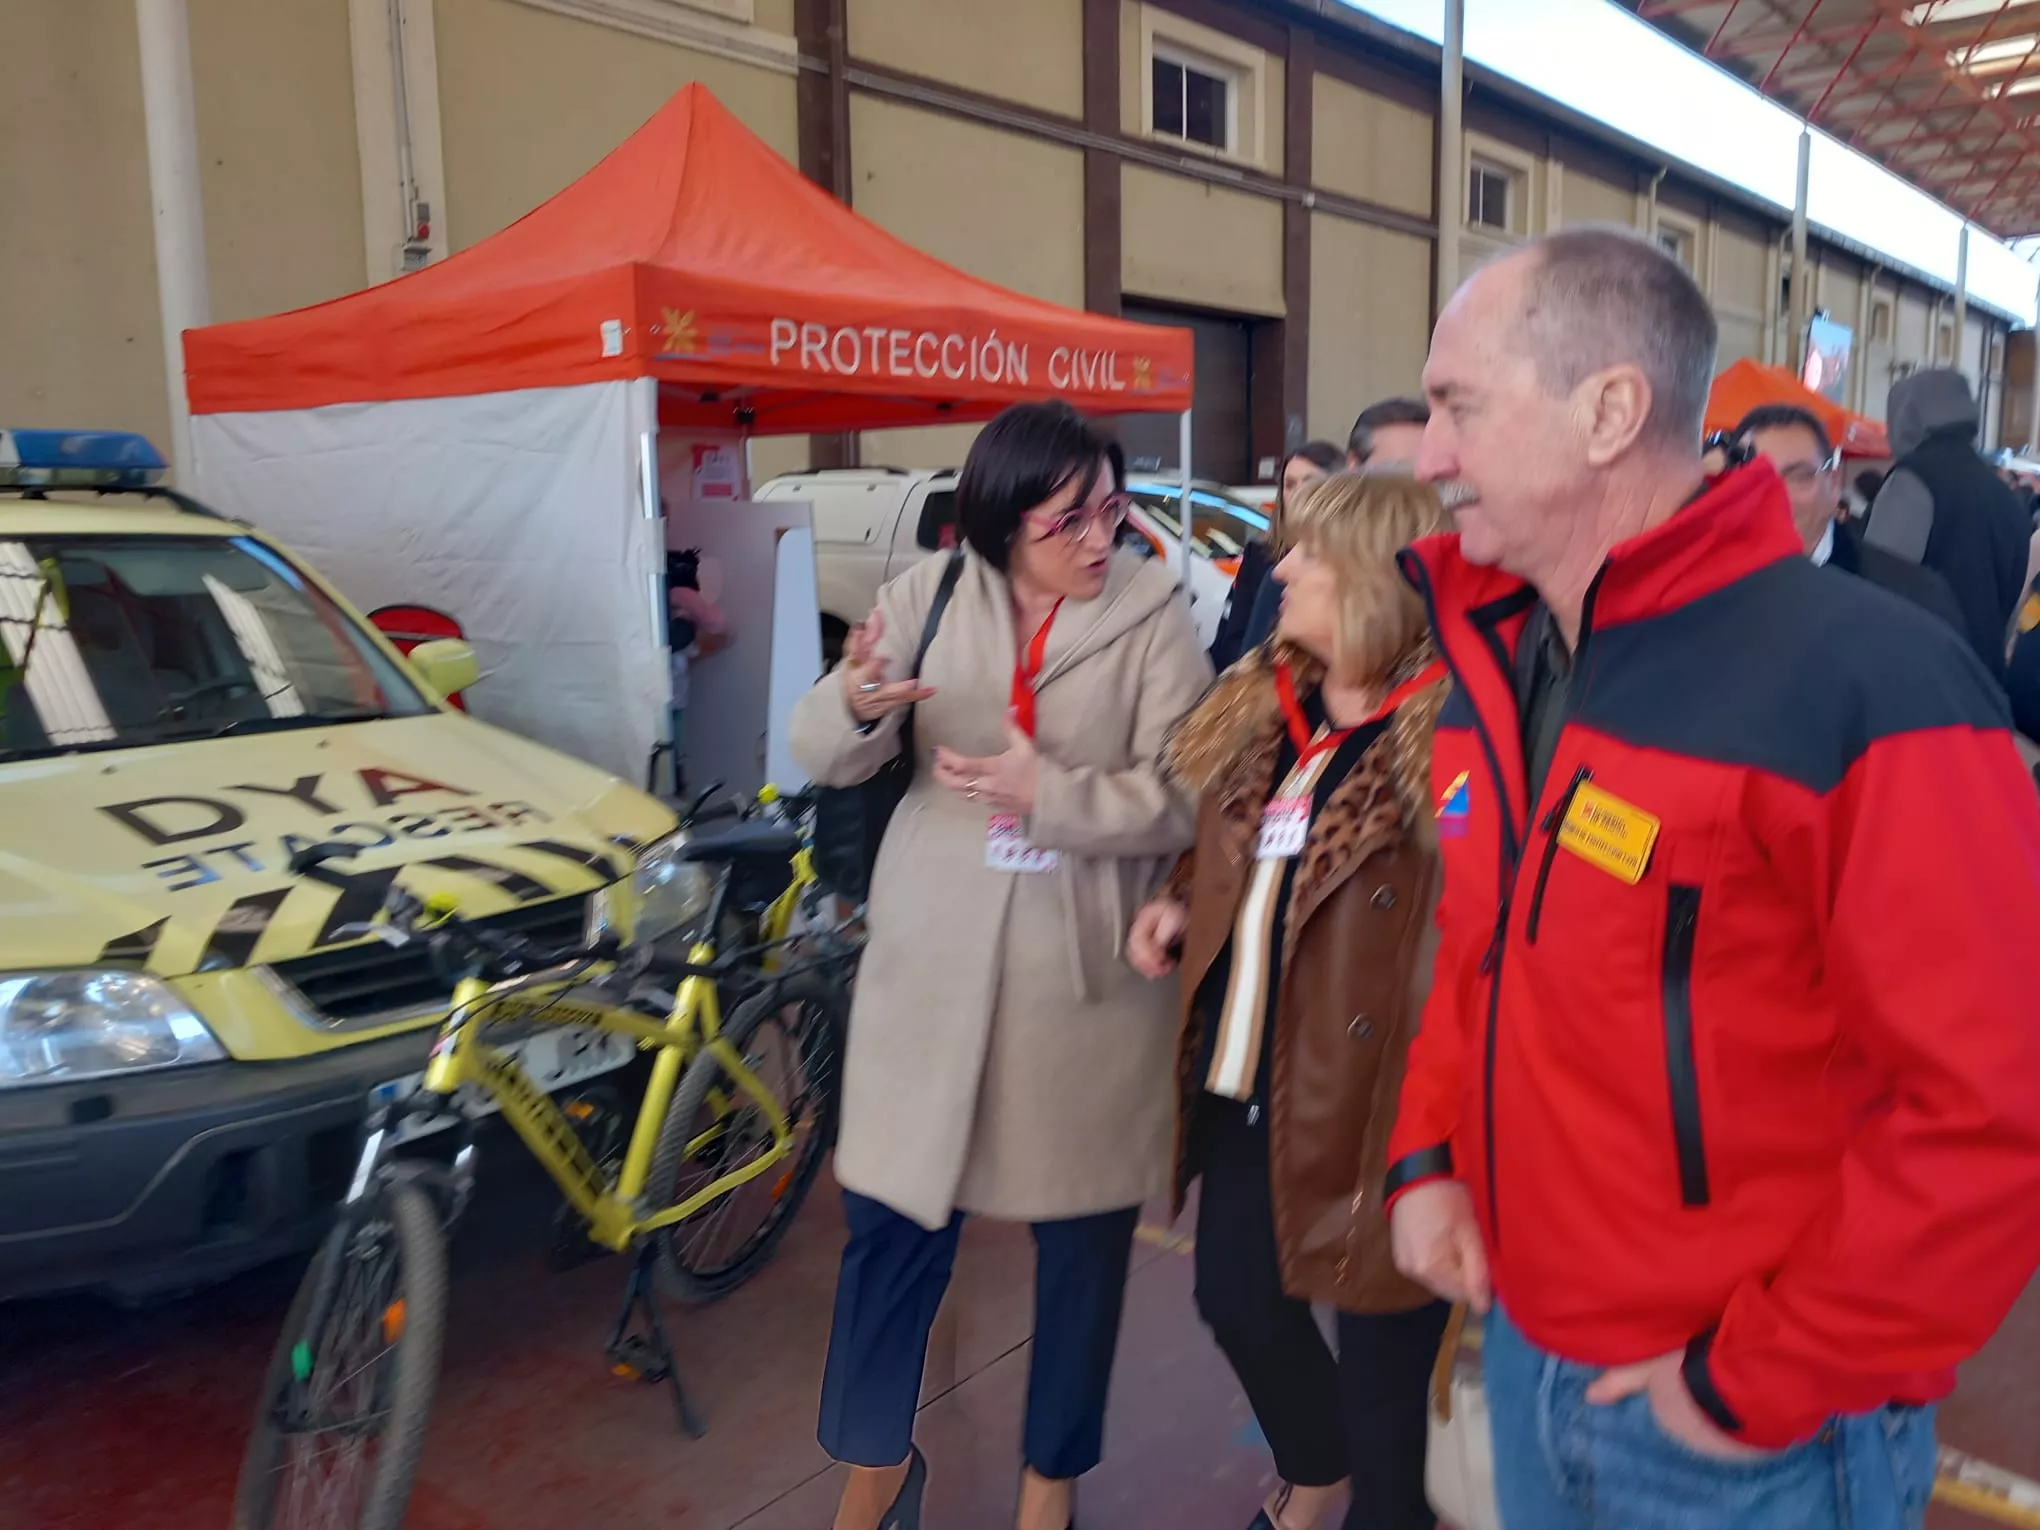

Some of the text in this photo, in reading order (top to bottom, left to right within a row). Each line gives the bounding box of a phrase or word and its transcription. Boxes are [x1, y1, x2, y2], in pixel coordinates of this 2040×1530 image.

[770, 317, 1029, 387] PROTECCIÓN
[1048, 346, 1126, 391] CIVIL
[95, 767, 477, 845] DYA
